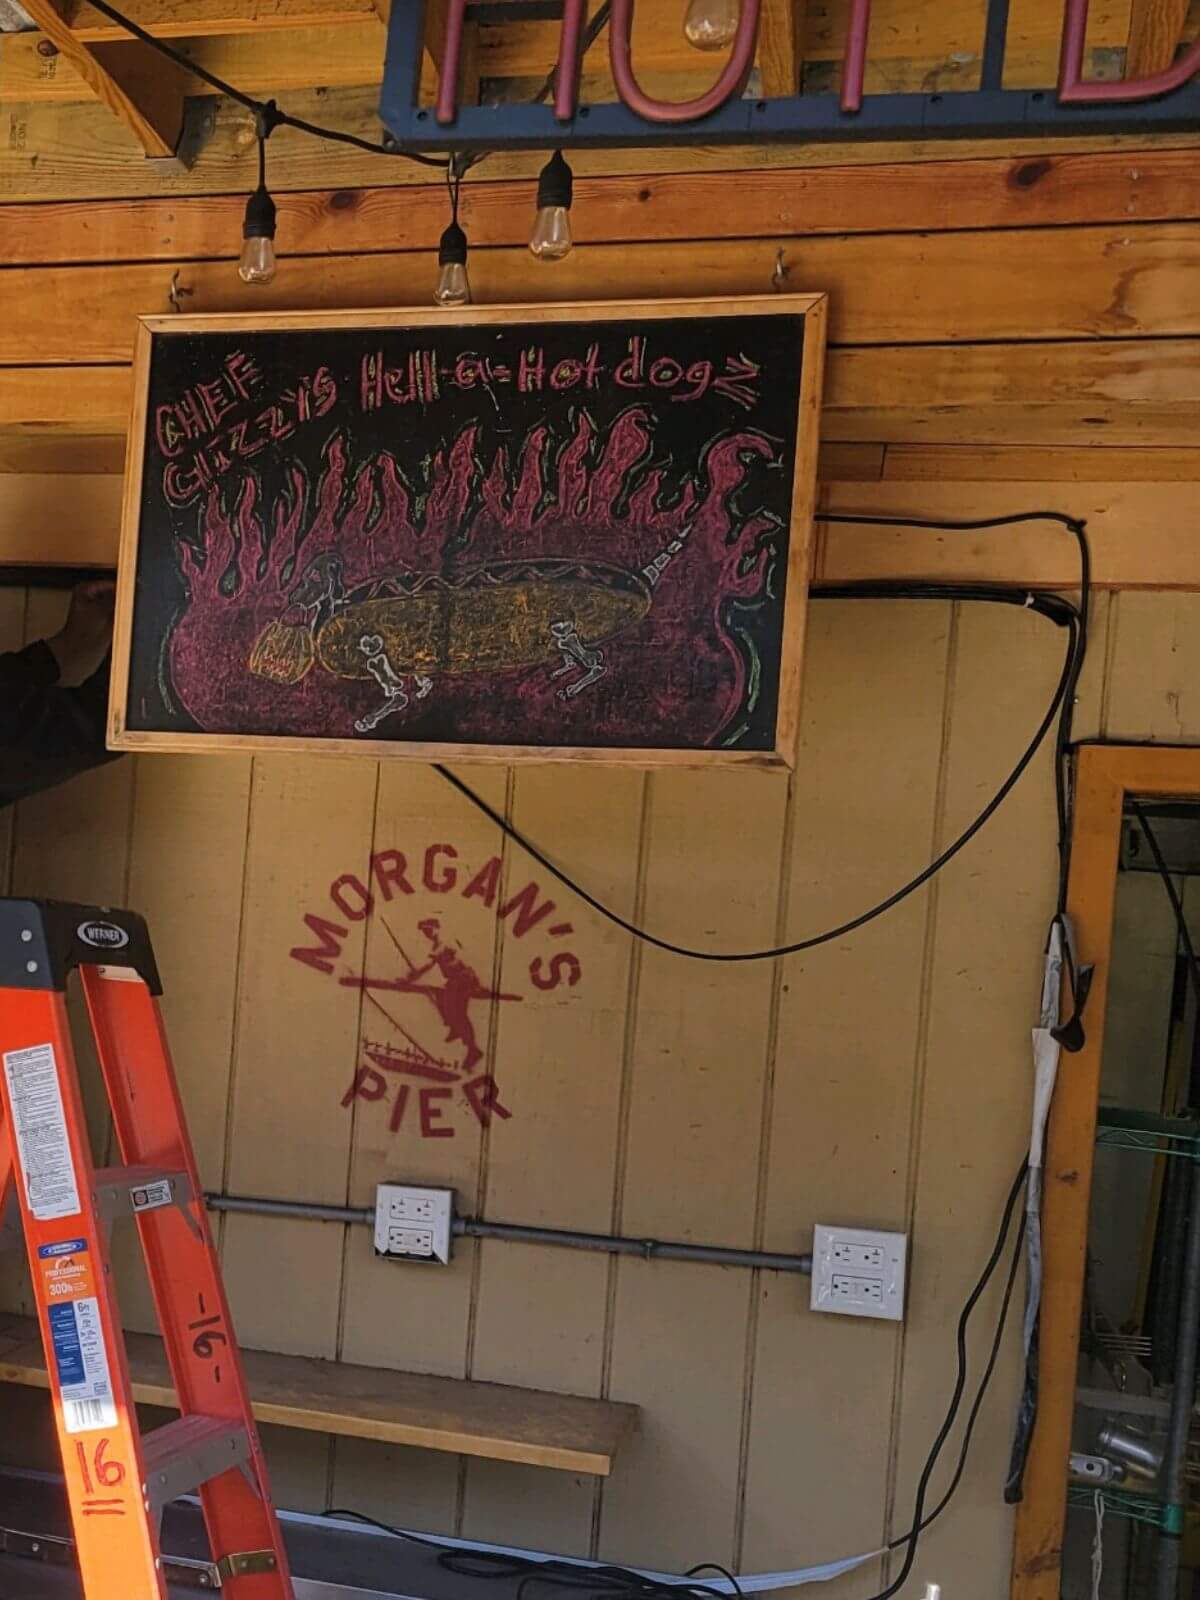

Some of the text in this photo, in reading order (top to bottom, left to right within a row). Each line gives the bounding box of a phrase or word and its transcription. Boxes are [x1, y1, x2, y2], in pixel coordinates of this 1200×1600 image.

[155, 350, 263, 458] CHEF
[87, 927, 121, 942] WERNER
[289, 843, 582, 991] MORGAN'S
[340, 1064, 513, 1138] PIER
[75, 1438, 127, 1496] 16
